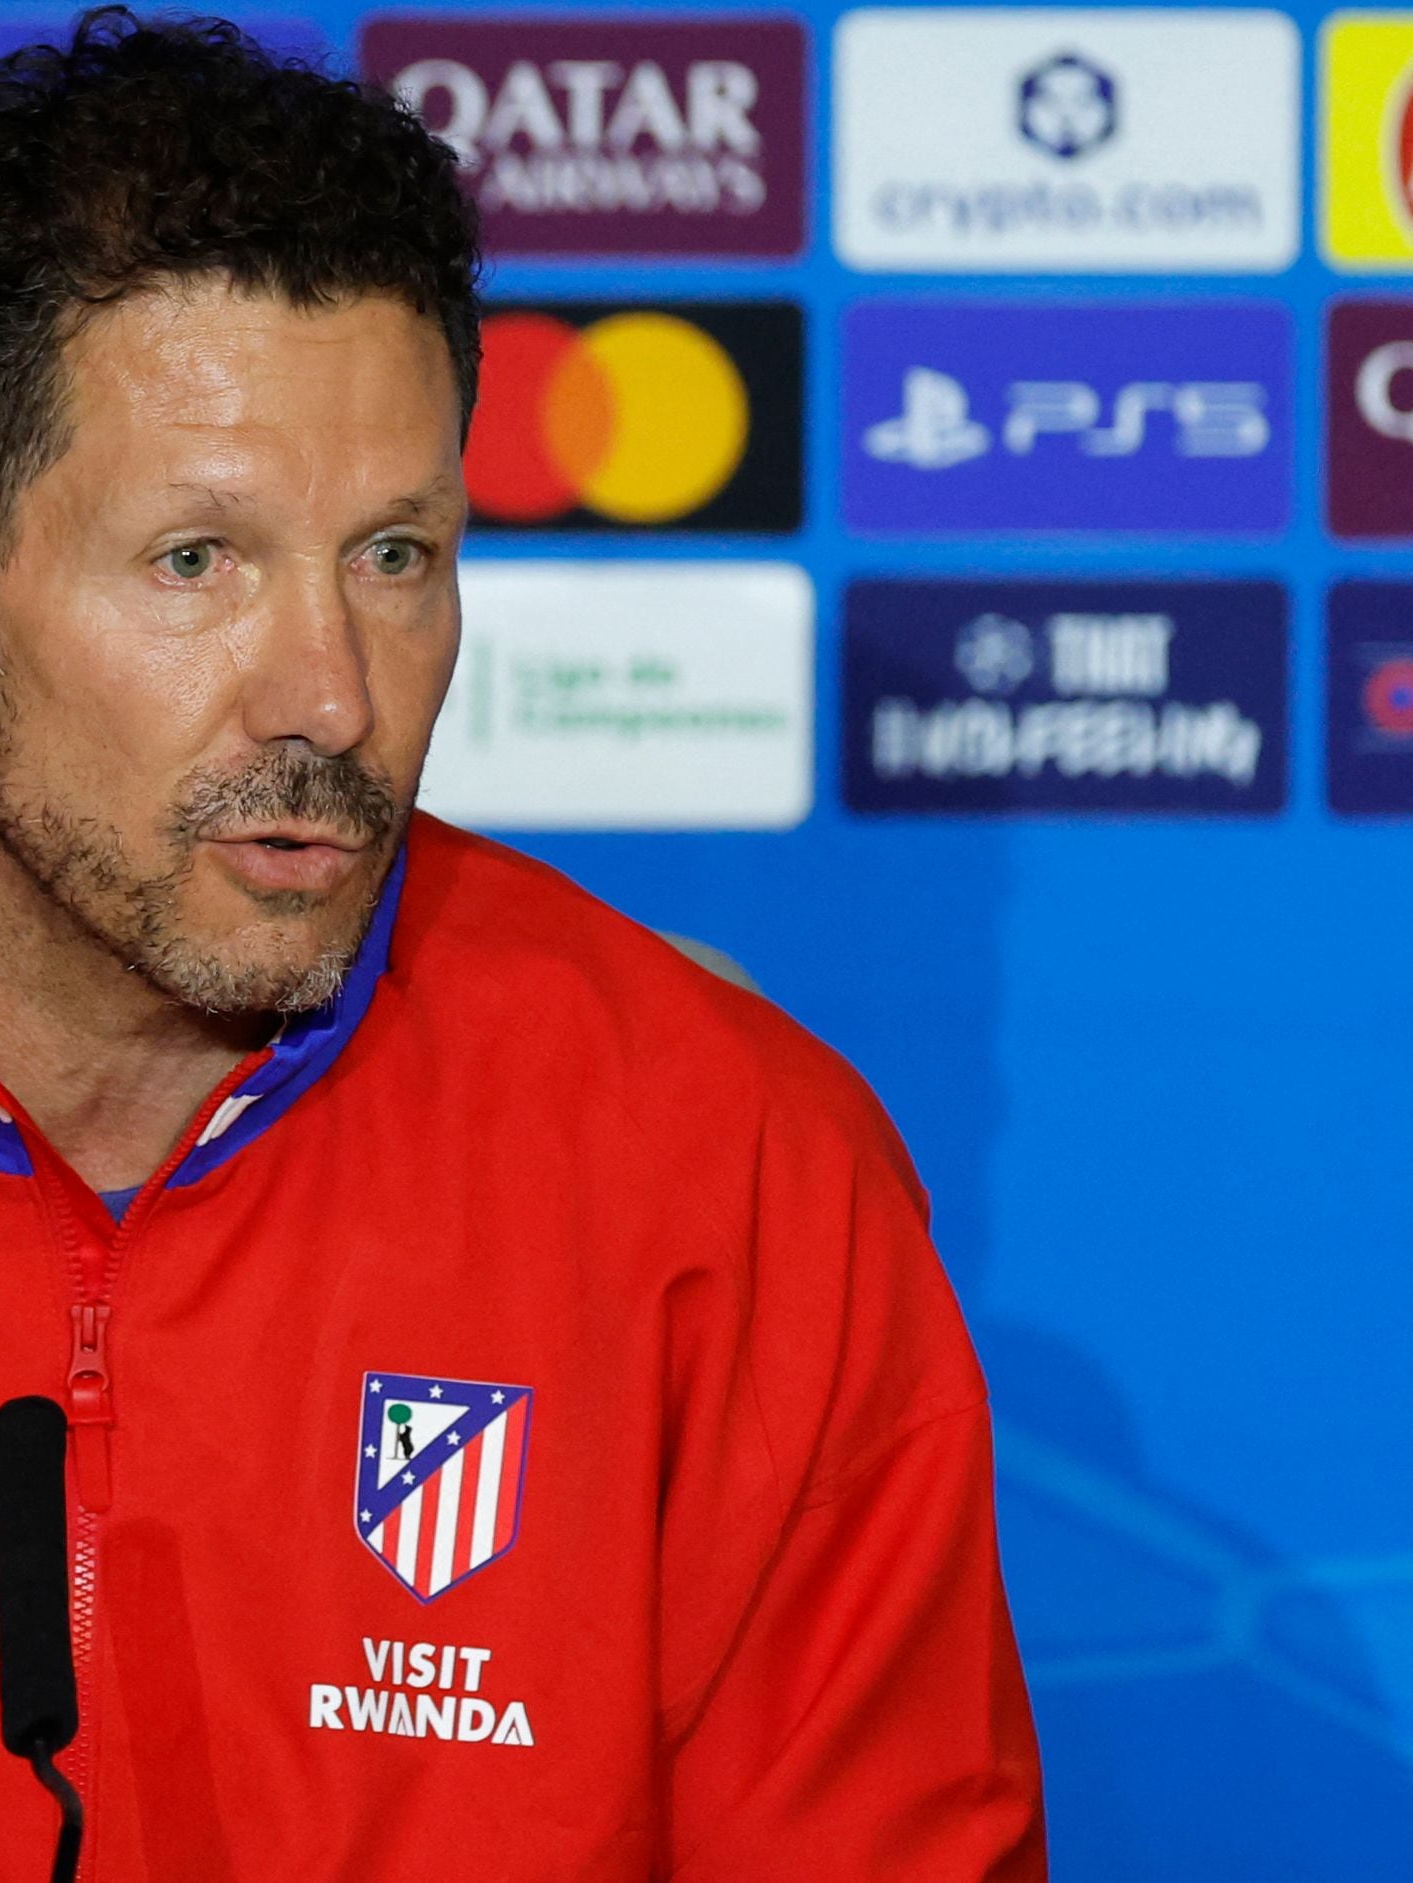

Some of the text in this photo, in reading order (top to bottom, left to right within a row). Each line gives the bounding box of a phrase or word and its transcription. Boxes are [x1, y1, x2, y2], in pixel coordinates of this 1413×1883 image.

[391, 58, 763, 168] QATAR
[873, 177, 1263, 238] crypto.com
[1003, 380, 1270, 458] PS5
[361, 1636, 492, 1693] VISIT
[308, 1683, 535, 1747] RWANDA
